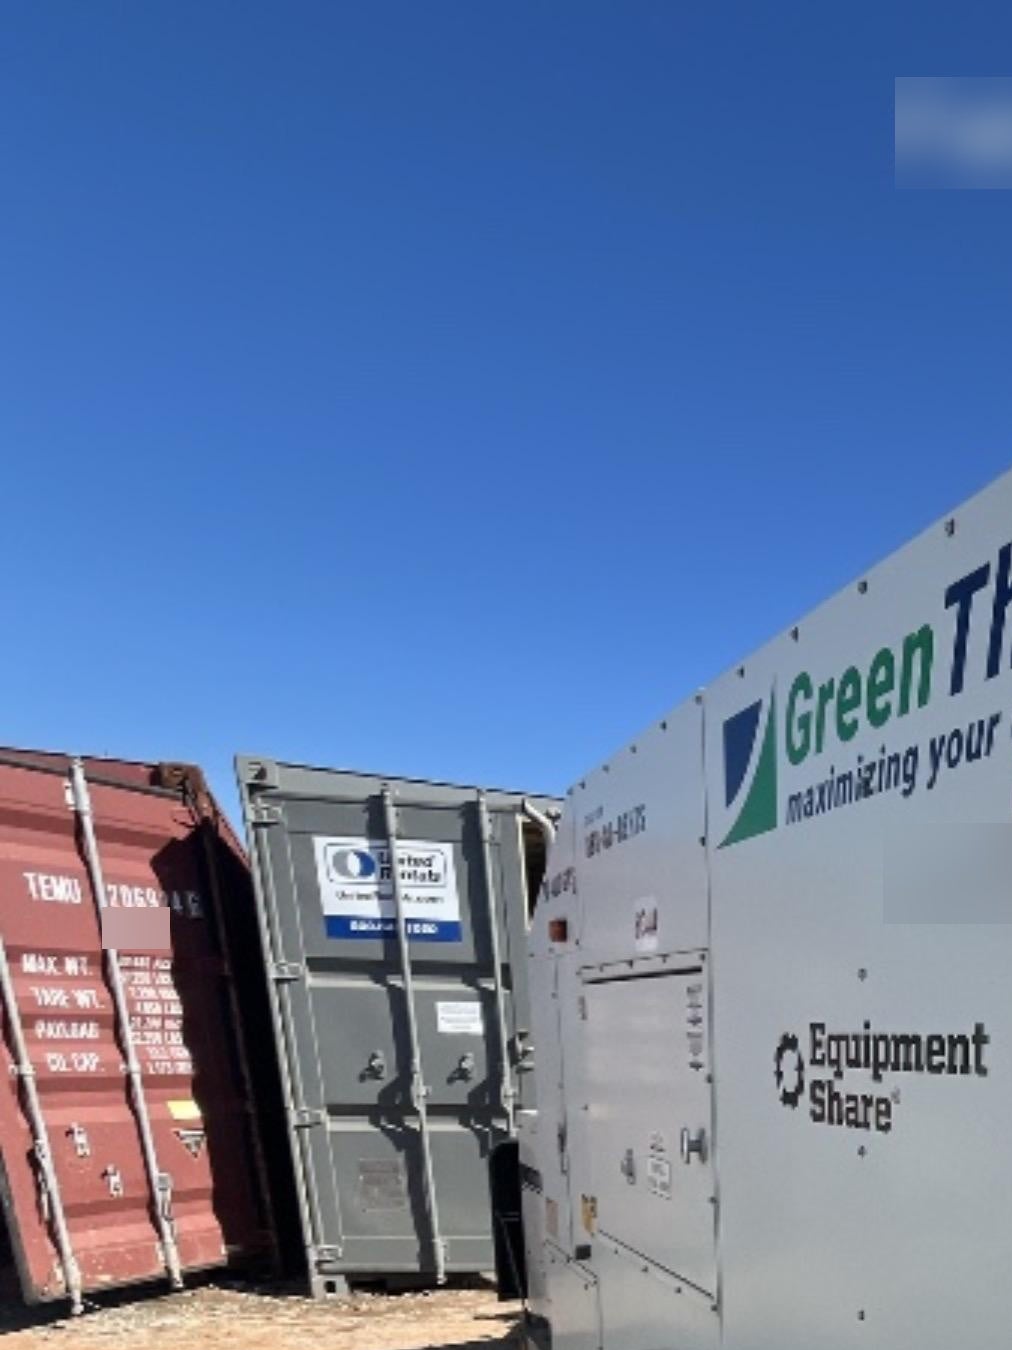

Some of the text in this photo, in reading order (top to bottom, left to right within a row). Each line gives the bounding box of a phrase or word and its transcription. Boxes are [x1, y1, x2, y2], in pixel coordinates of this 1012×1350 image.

[786, 746, 919, 824] maximizing
[927, 710, 1001, 789] your
[23, 872, 82, 905] TEMU
[809, 1020, 989, 1083] Equipment
[809, 1079, 892, 1134] Share
